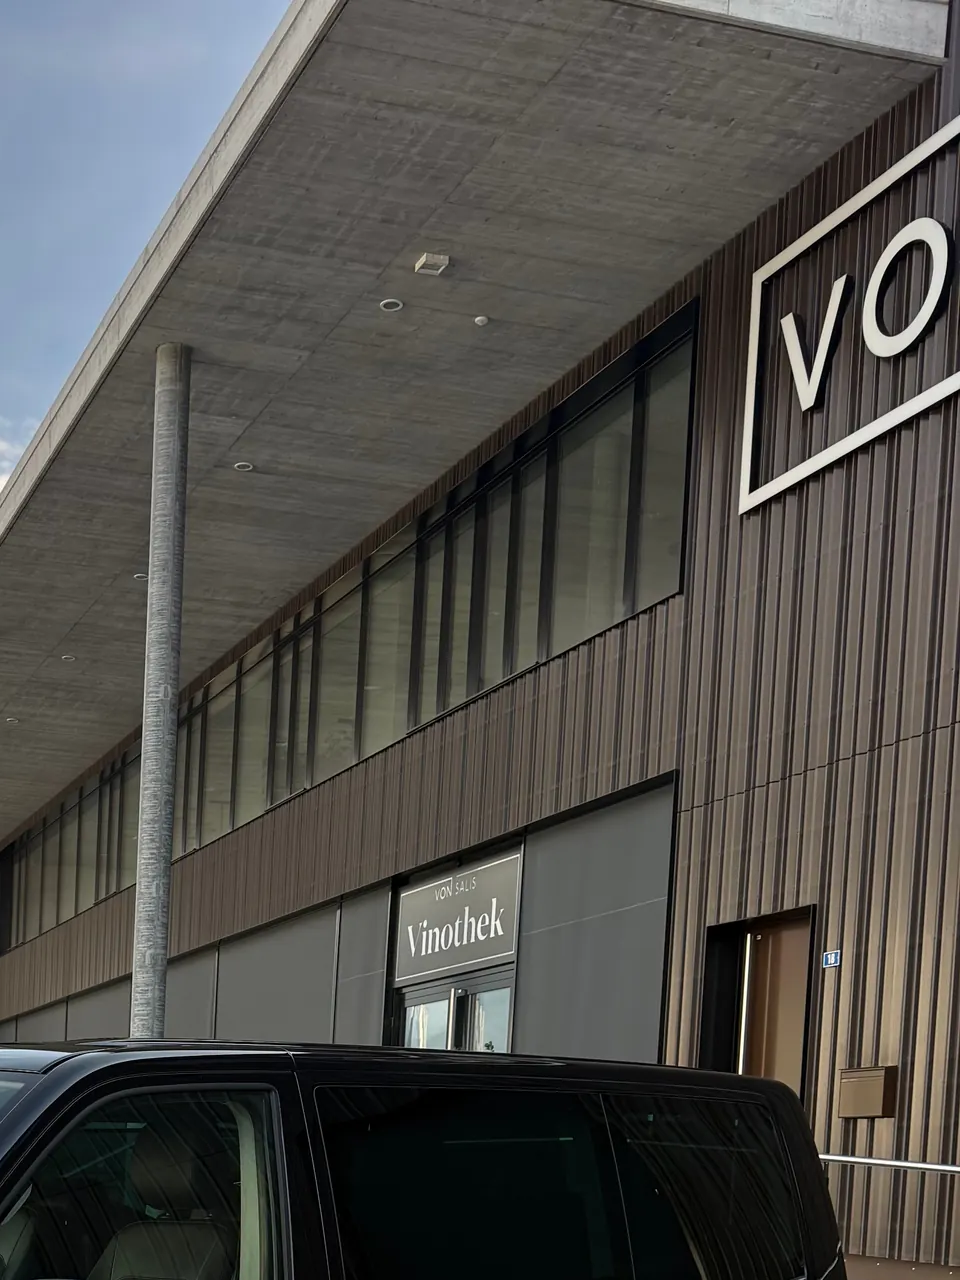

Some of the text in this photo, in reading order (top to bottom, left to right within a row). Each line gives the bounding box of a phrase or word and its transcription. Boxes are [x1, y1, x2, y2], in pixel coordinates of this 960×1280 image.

[780, 216, 949, 412] VO
[434, 876, 477, 901] VON SALIS
[407, 897, 505, 957] Vinothek
